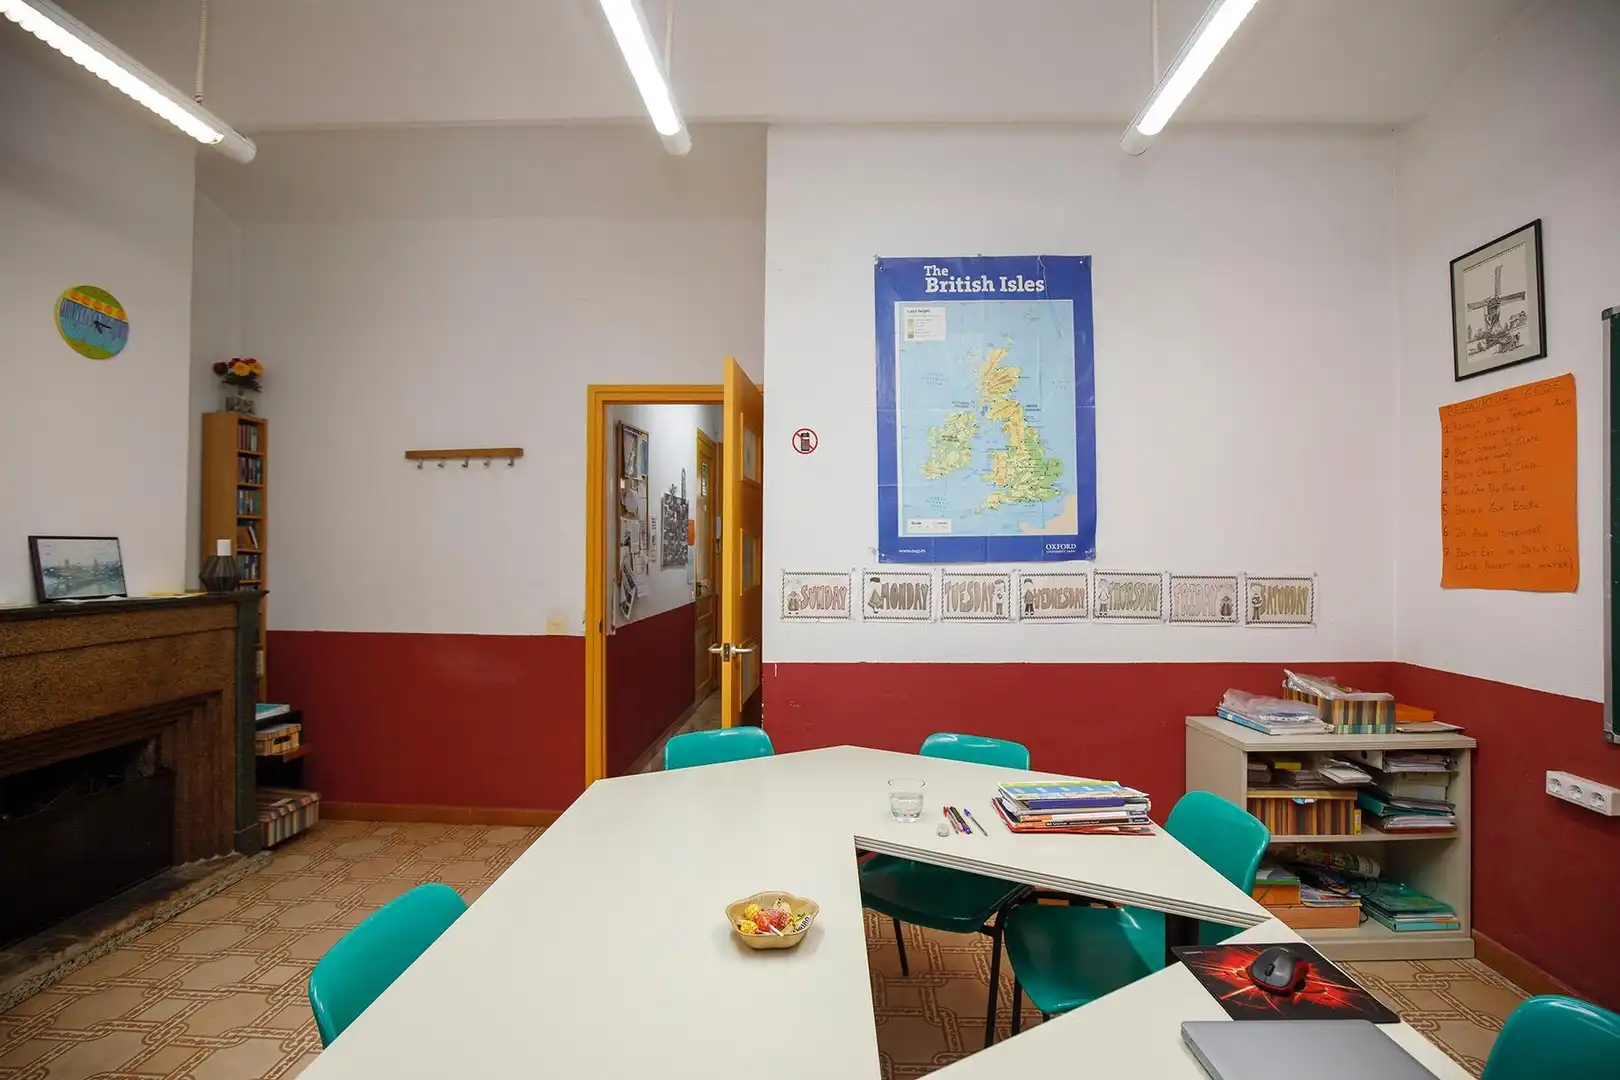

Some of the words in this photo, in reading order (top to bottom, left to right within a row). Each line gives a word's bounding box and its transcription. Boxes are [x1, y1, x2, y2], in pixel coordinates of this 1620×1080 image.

[924, 265, 949, 276] The
[925, 275, 995, 293] British
[1000, 276, 1045, 292] Isles
[800, 584, 848, 611] SUNDAY
[880, 581, 929, 611] MONDAY
[945, 580, 995, 613] TUESDAY
[1109, 581, 1160, 611] THURSDAY
[1260, 585, 1310, 616] SATURDAY
